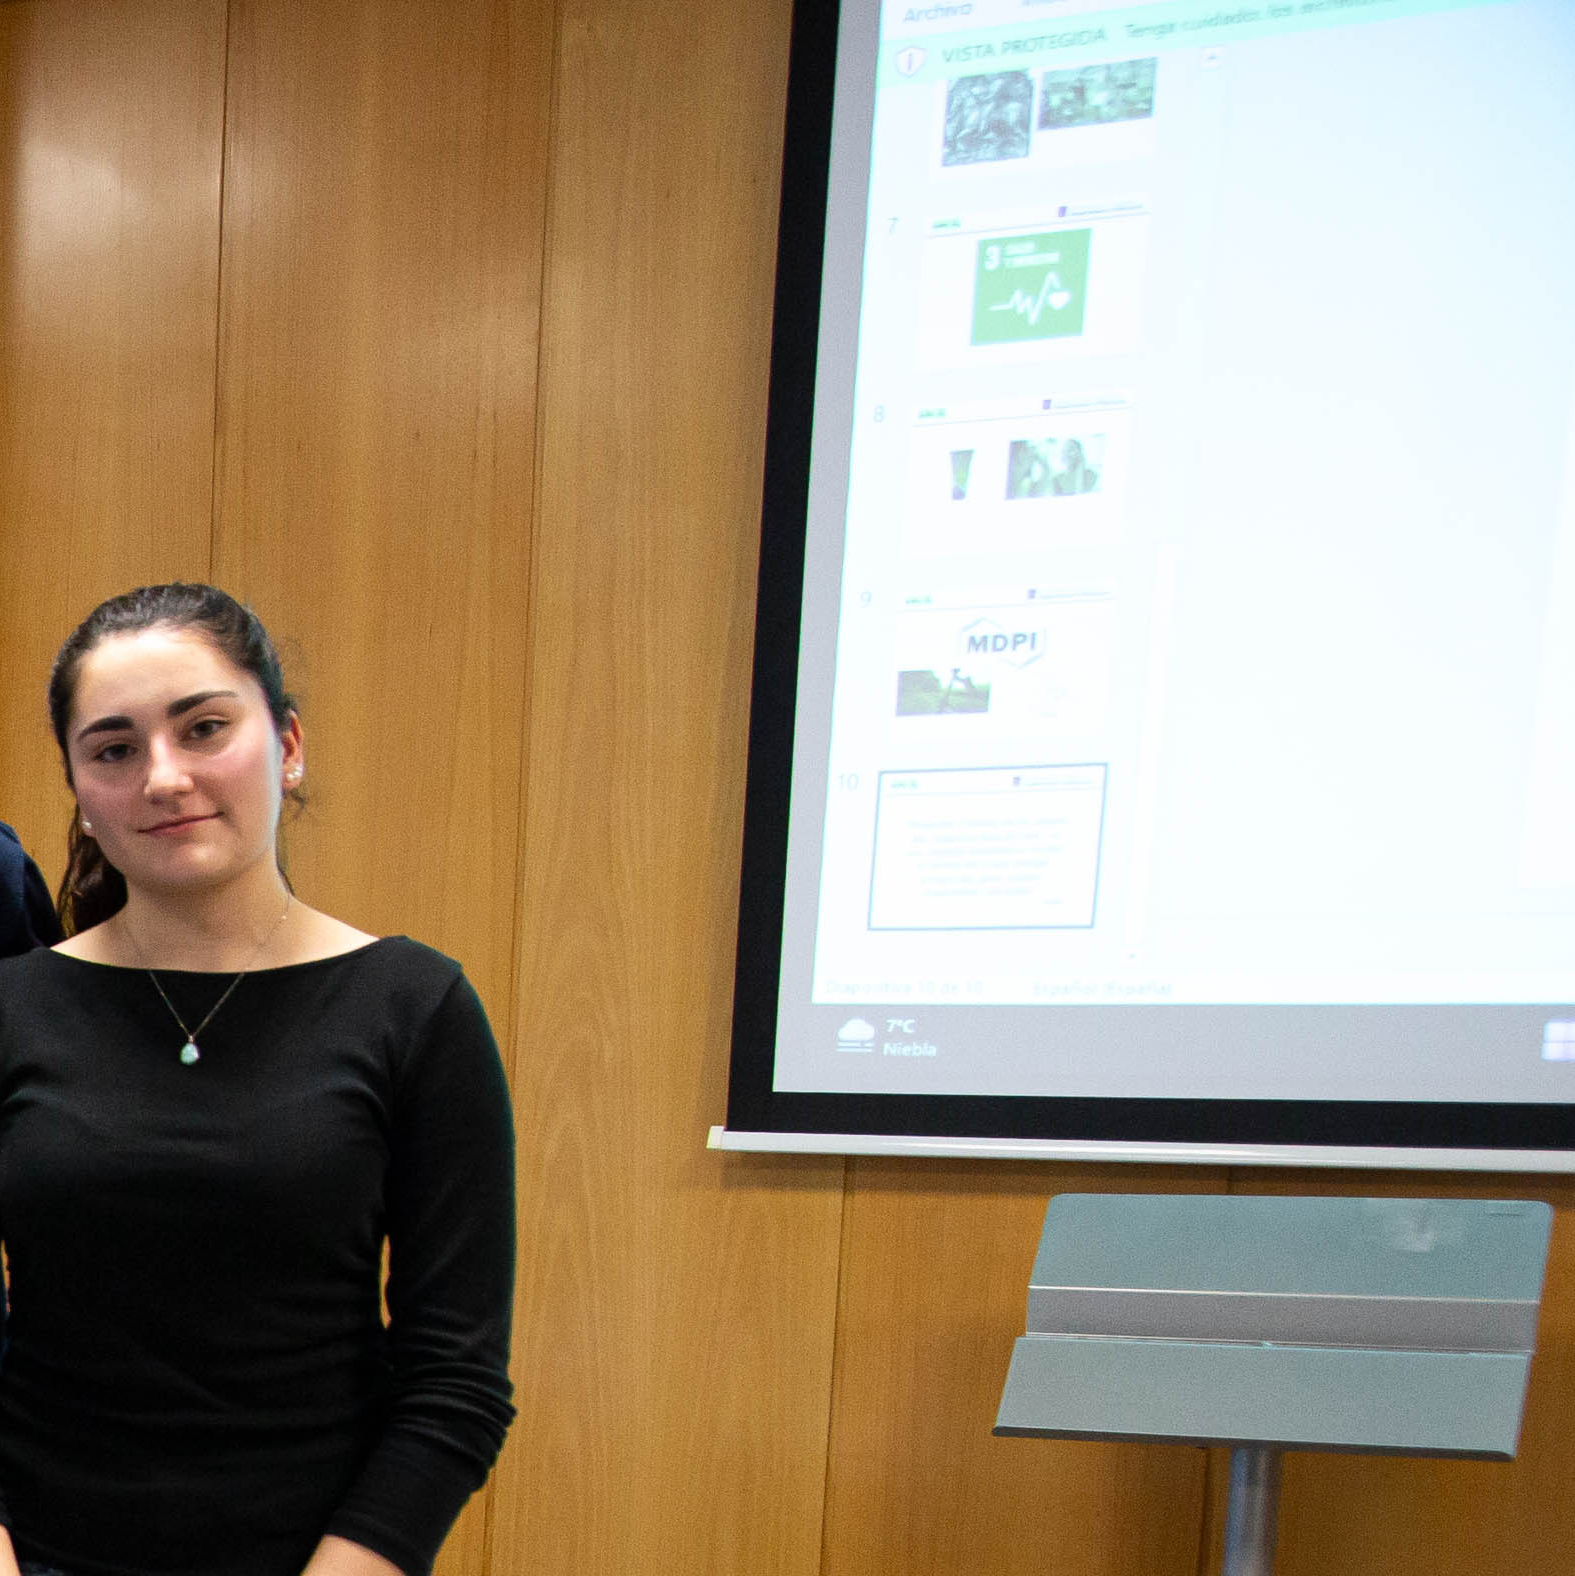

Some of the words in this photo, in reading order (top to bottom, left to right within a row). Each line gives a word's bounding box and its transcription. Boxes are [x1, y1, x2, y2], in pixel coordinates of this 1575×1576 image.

[903, 3, 973, 22] Archivo
[941, 43, 994, 63] VISTA
[1000, 28, 1106, 56] PROTEGIDA
[984, 245, 1001, 271] 3
[873, 404, 886, 424] 8
[859, 591, 873, 609] 9
[966, 631, 1039, 654] MDPI
[837, 773, 859, 791] 10
[882, 1042, 938, 1057] Niebla
